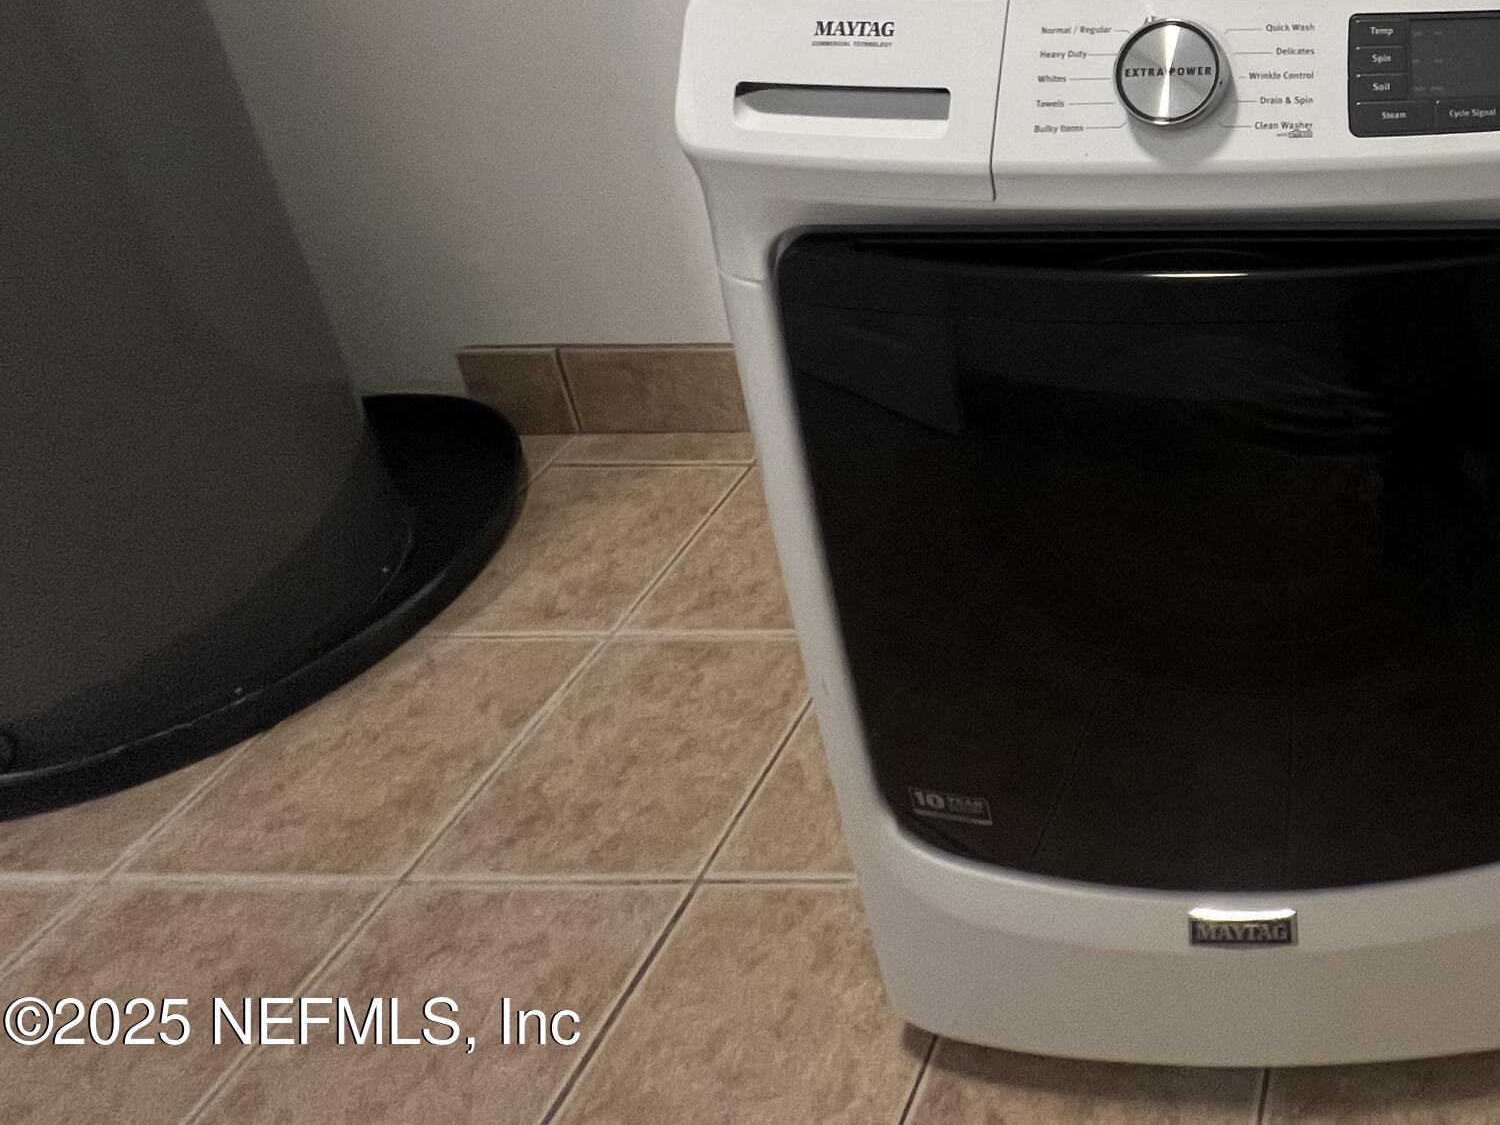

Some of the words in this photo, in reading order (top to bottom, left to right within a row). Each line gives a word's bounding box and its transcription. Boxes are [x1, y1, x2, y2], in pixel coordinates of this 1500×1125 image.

[814, 20, 895, 37] MAYTAG
[1041, 26, 1071, 35] Normal
[1080, 25, 1112, 35] Regular
[1266, 23, 1290, 32] Quick
[1291, 22, 1315, 32] Wash
[1370, 26, 1394, 37] Temp
[1039, 50, 1065, 60] Heavy
[1067, 50, 1087, 59] Duty
[1276, 47, 1315, 56] Delicates
[1372, 54, 1392, 64] Spin
[1124, 67, 1165, 78] EXTRA
[1168, 66, 1213, 76] POWER
[1248, 71, 1281, 80] Wrinkle
[1283, 71, 1314, 80] Control
[1037, 74, 1067, 83] Whites
[1372, 82, 1391, 91] Soil
[1036, 99, 1065, 108] Towels
[1260, 96, 1283, 104] Drain
[1284, 96, 1292, 105] &
[1293, 95, 1314, 106] Spin
[1381, 111, 1407, 120] Steam
[1449, 109, 1470, 118] Cycle
[1472, 108, 1497, 118] Signal
[1033, 124, 1059, 135] Bulky
[1060, 124, 1085, 133] Items
[1254, 121, 1279, 130] Clean
[1280, 121, 1313, 130] Washer
[1195, 923, 1290, 942] MAYTAG
